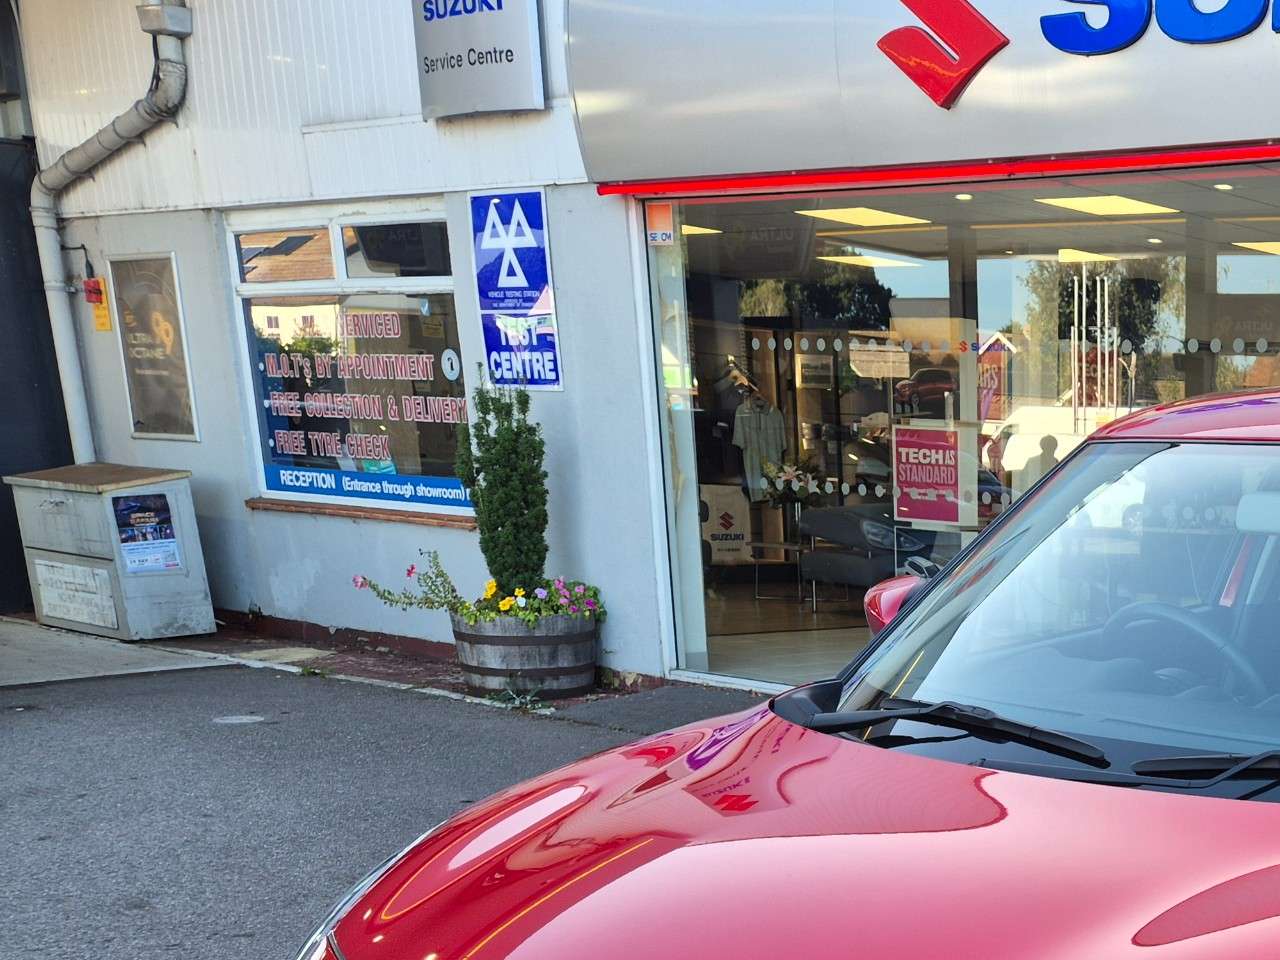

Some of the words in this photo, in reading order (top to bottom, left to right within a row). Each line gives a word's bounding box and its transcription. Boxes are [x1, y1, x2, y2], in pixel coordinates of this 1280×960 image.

[423, 52, 463, 74] Service
[467, 47, 514, 67] Centre
[650, 232, 672, 242] SEOM
[265, 353, 312, 377] M.O.T's
[315, 354, 331, 377] BY
[338, 354, 434, 380] APPOINTMENT
[490, 351, 556, 379] CENTRE
[270, 392, 301, 417] FREE
[304, 393, 383, 420] COLLECTION
[388, 395, 399, 420] &
[402, 396, 468, 423] DELIVERY
[275, 430, 307, 454] FREE
[308, 431, 341, 455] TYRE
[346, 434, 391, 459] CHECK
[899, 447, 943, 464] TECH
[945, 450, 955, 465] AS
[280, 470, 335, 489] RECEPTION
[342, 478, 381, 493] (Entrance
[382, 480, 414, 498] through
[416, 482, 465, 501] showroom)
[899, 464, 956, 484] STANDARD
